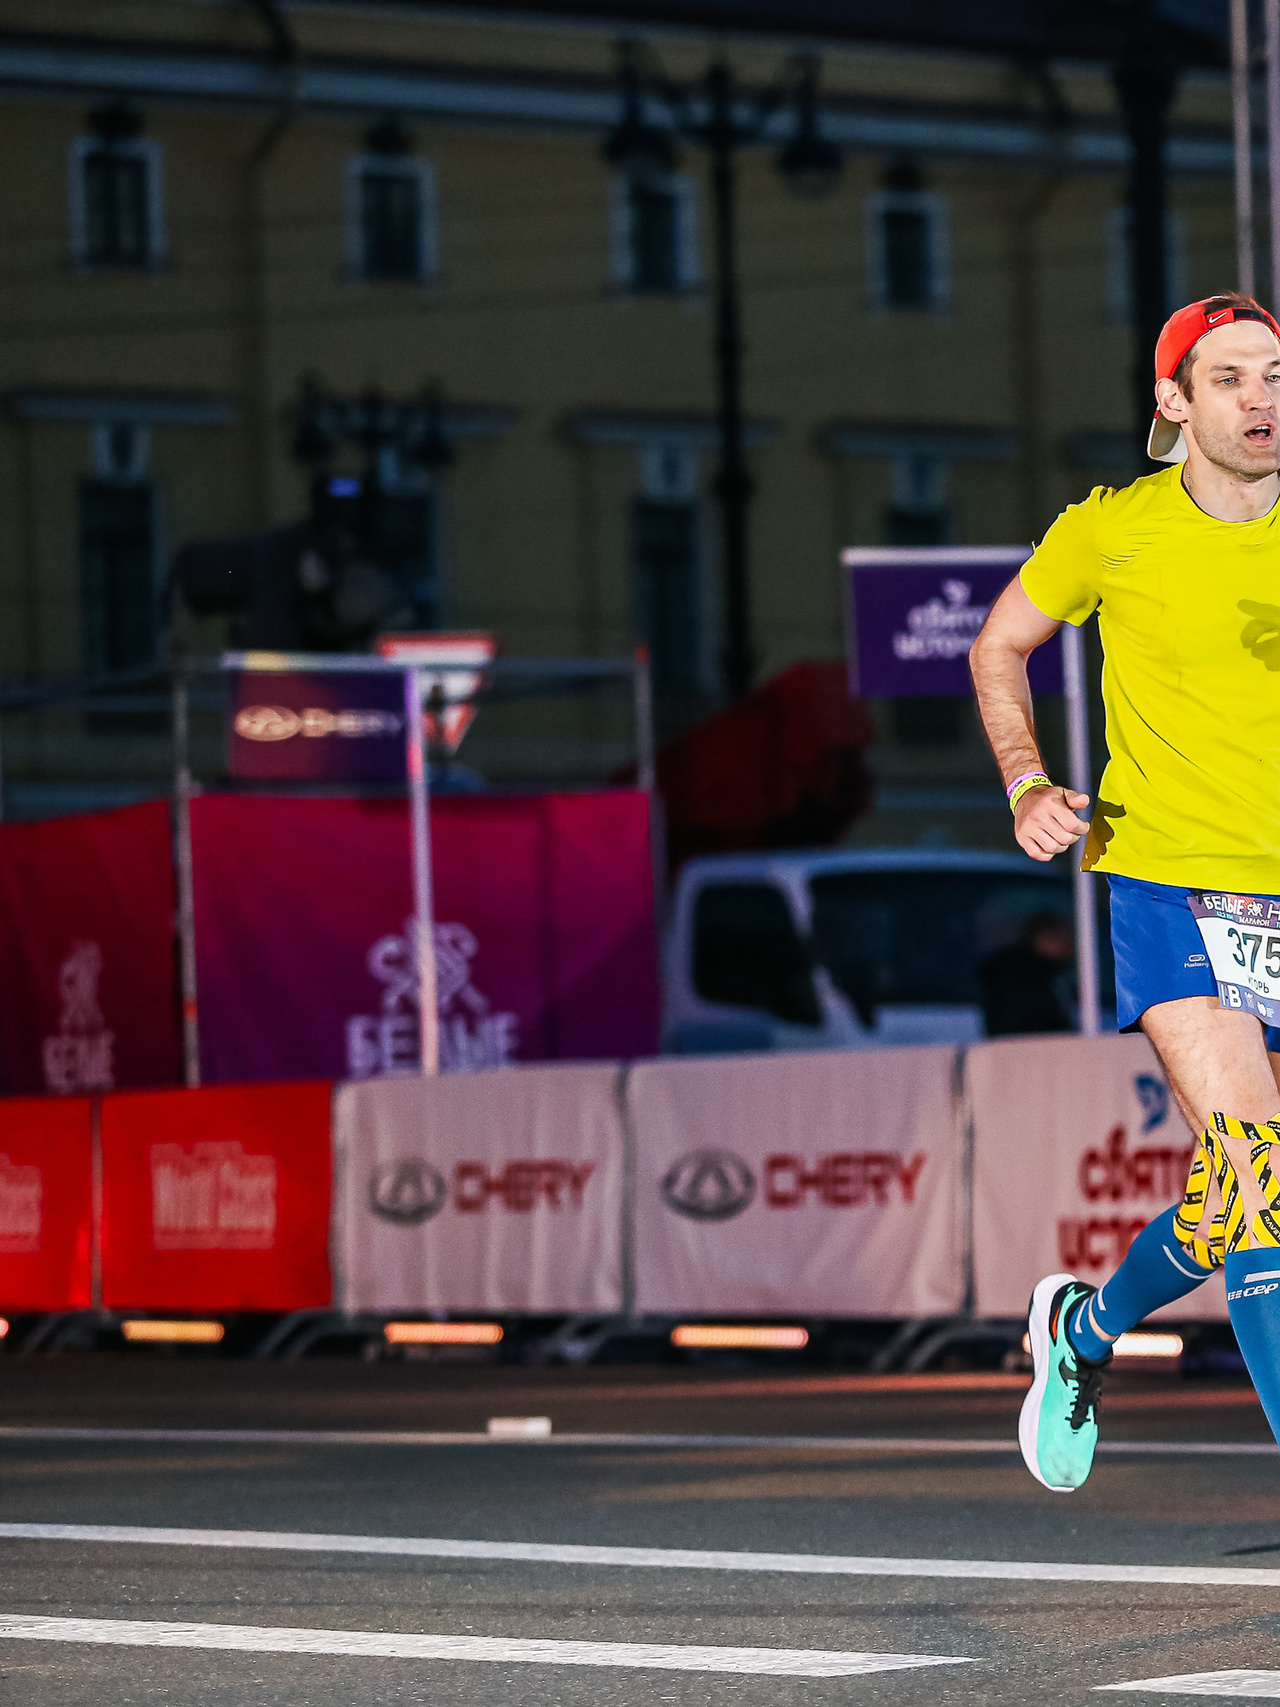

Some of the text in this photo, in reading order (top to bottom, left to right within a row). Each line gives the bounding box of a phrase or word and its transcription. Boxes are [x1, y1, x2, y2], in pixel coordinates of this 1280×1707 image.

[1202, 895, 1244, 916] БЕЛЫЕ
[454, 1159, 596, 1215] CHERY
[764, 1153, 927, 1209] CHERY
[1243, 1282, 1279, 1298] cep
